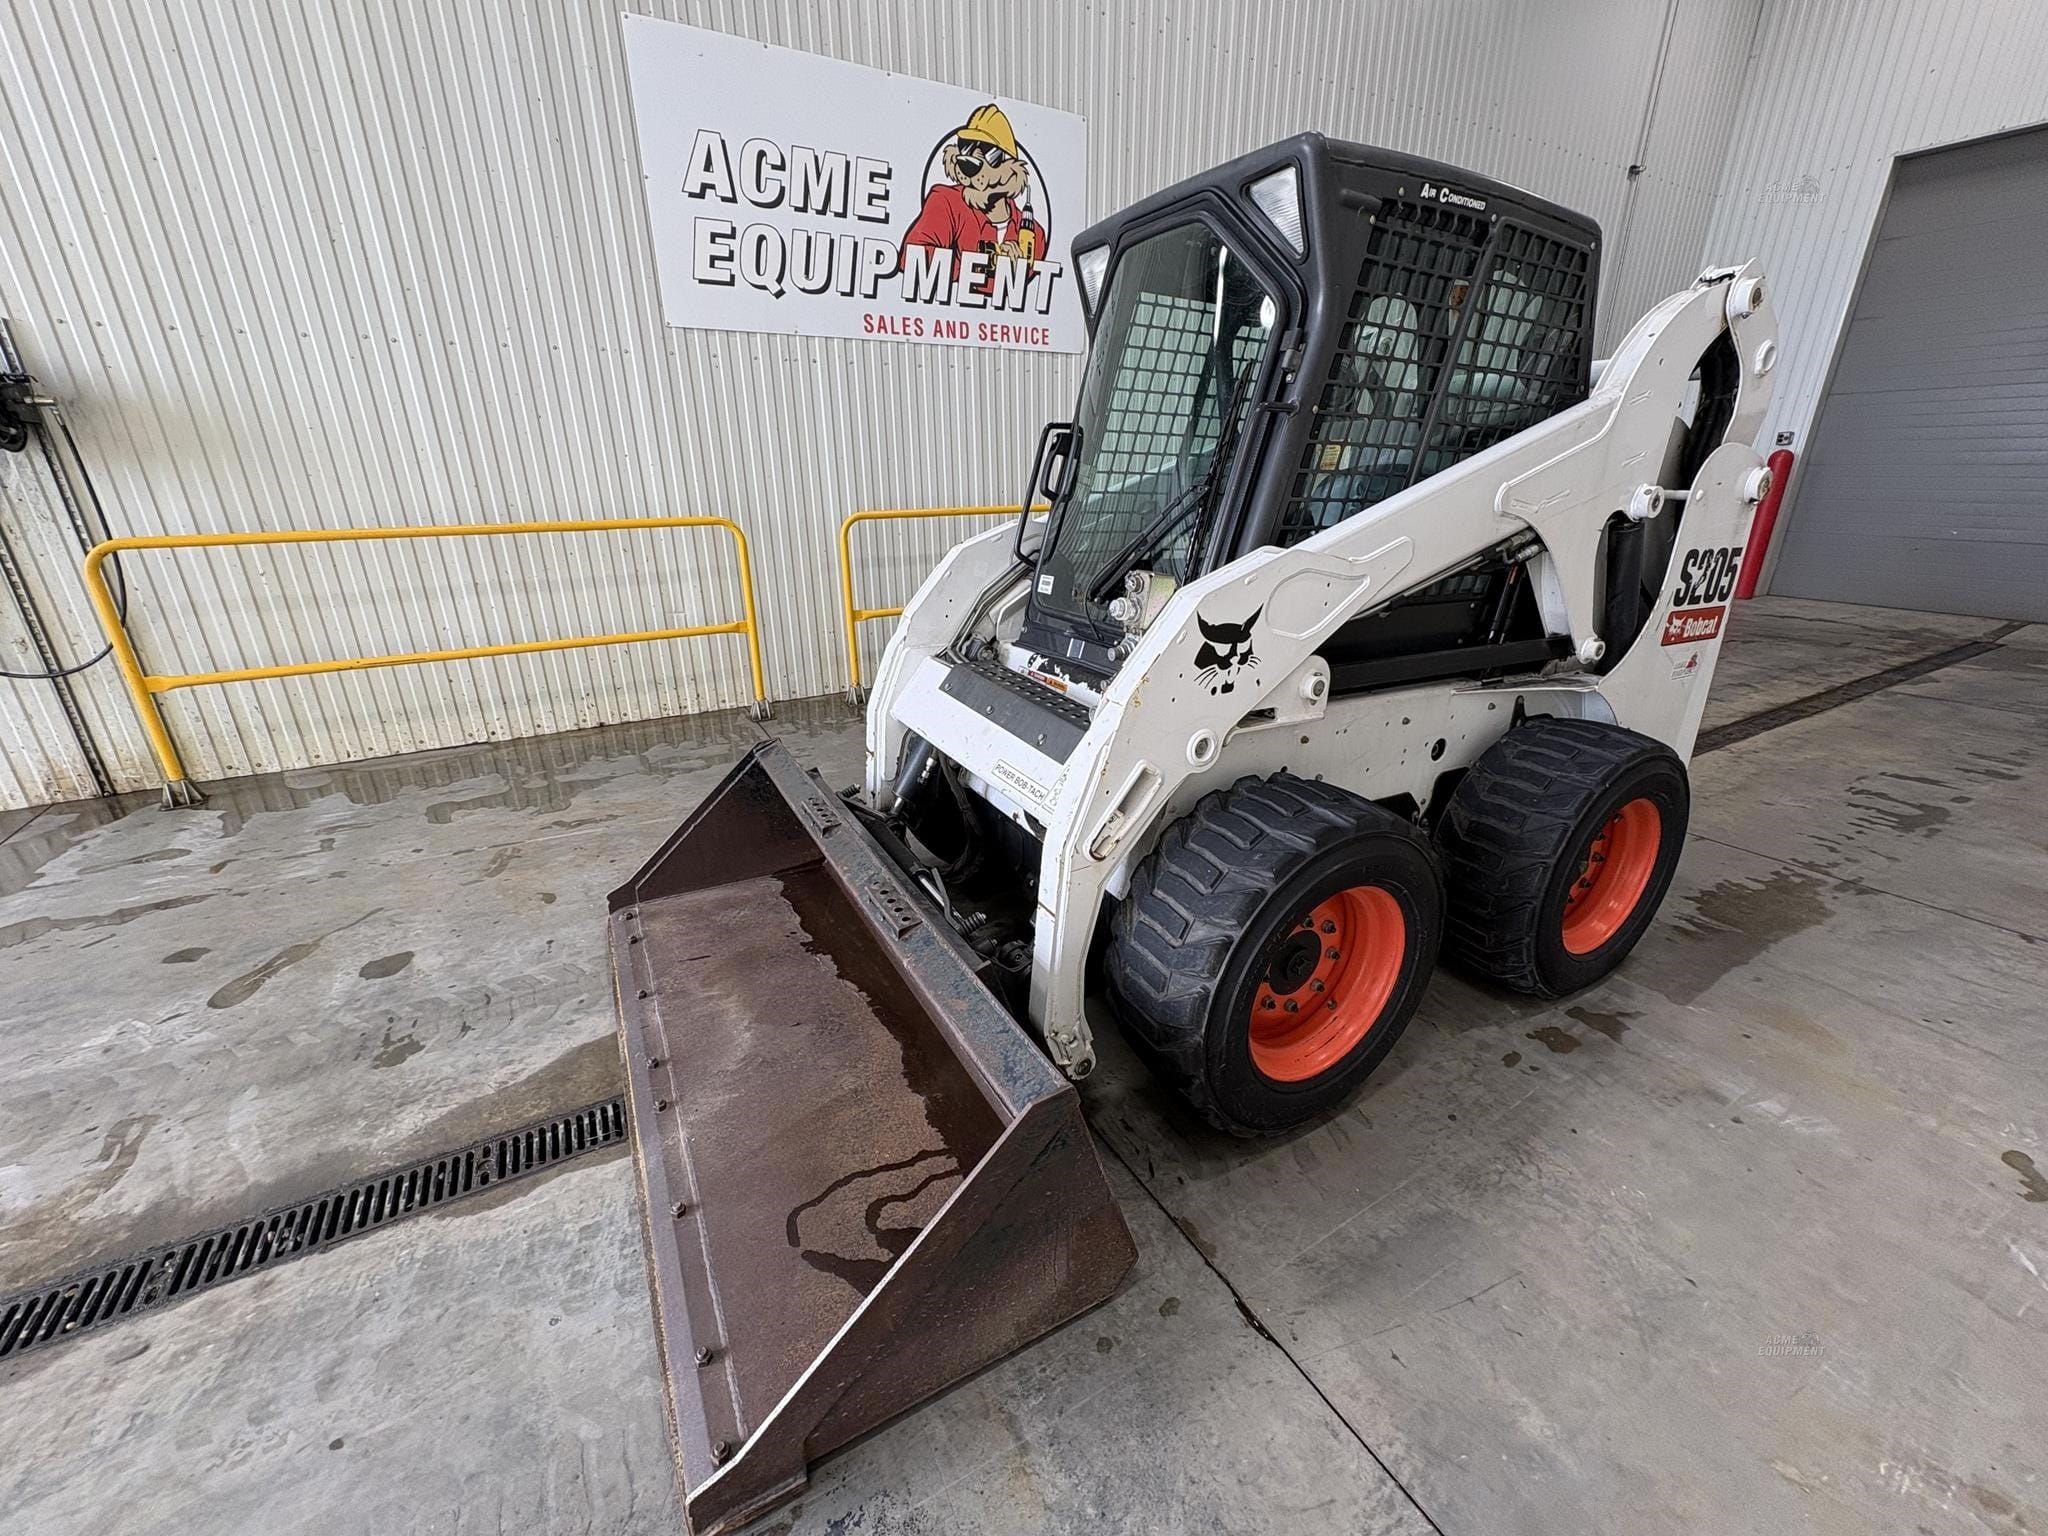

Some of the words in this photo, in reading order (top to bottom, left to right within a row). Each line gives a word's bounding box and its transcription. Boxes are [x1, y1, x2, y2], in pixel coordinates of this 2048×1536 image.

[682, 129, 893, 224] ACME
[692, 216, 1064, 315] EQUIPMENT
[863, 313, 924, 337] SALES
[933, 319, 970, 340] AND
[978, 323, 1050, 346] SERVICE
[1673, 547, 1744, 607] S205
[1683, 615, 1719, 638] Bobcat
[994, 763, 1016, 781] POWER
[1013, 776, 1045, 801] BOB-TACH
